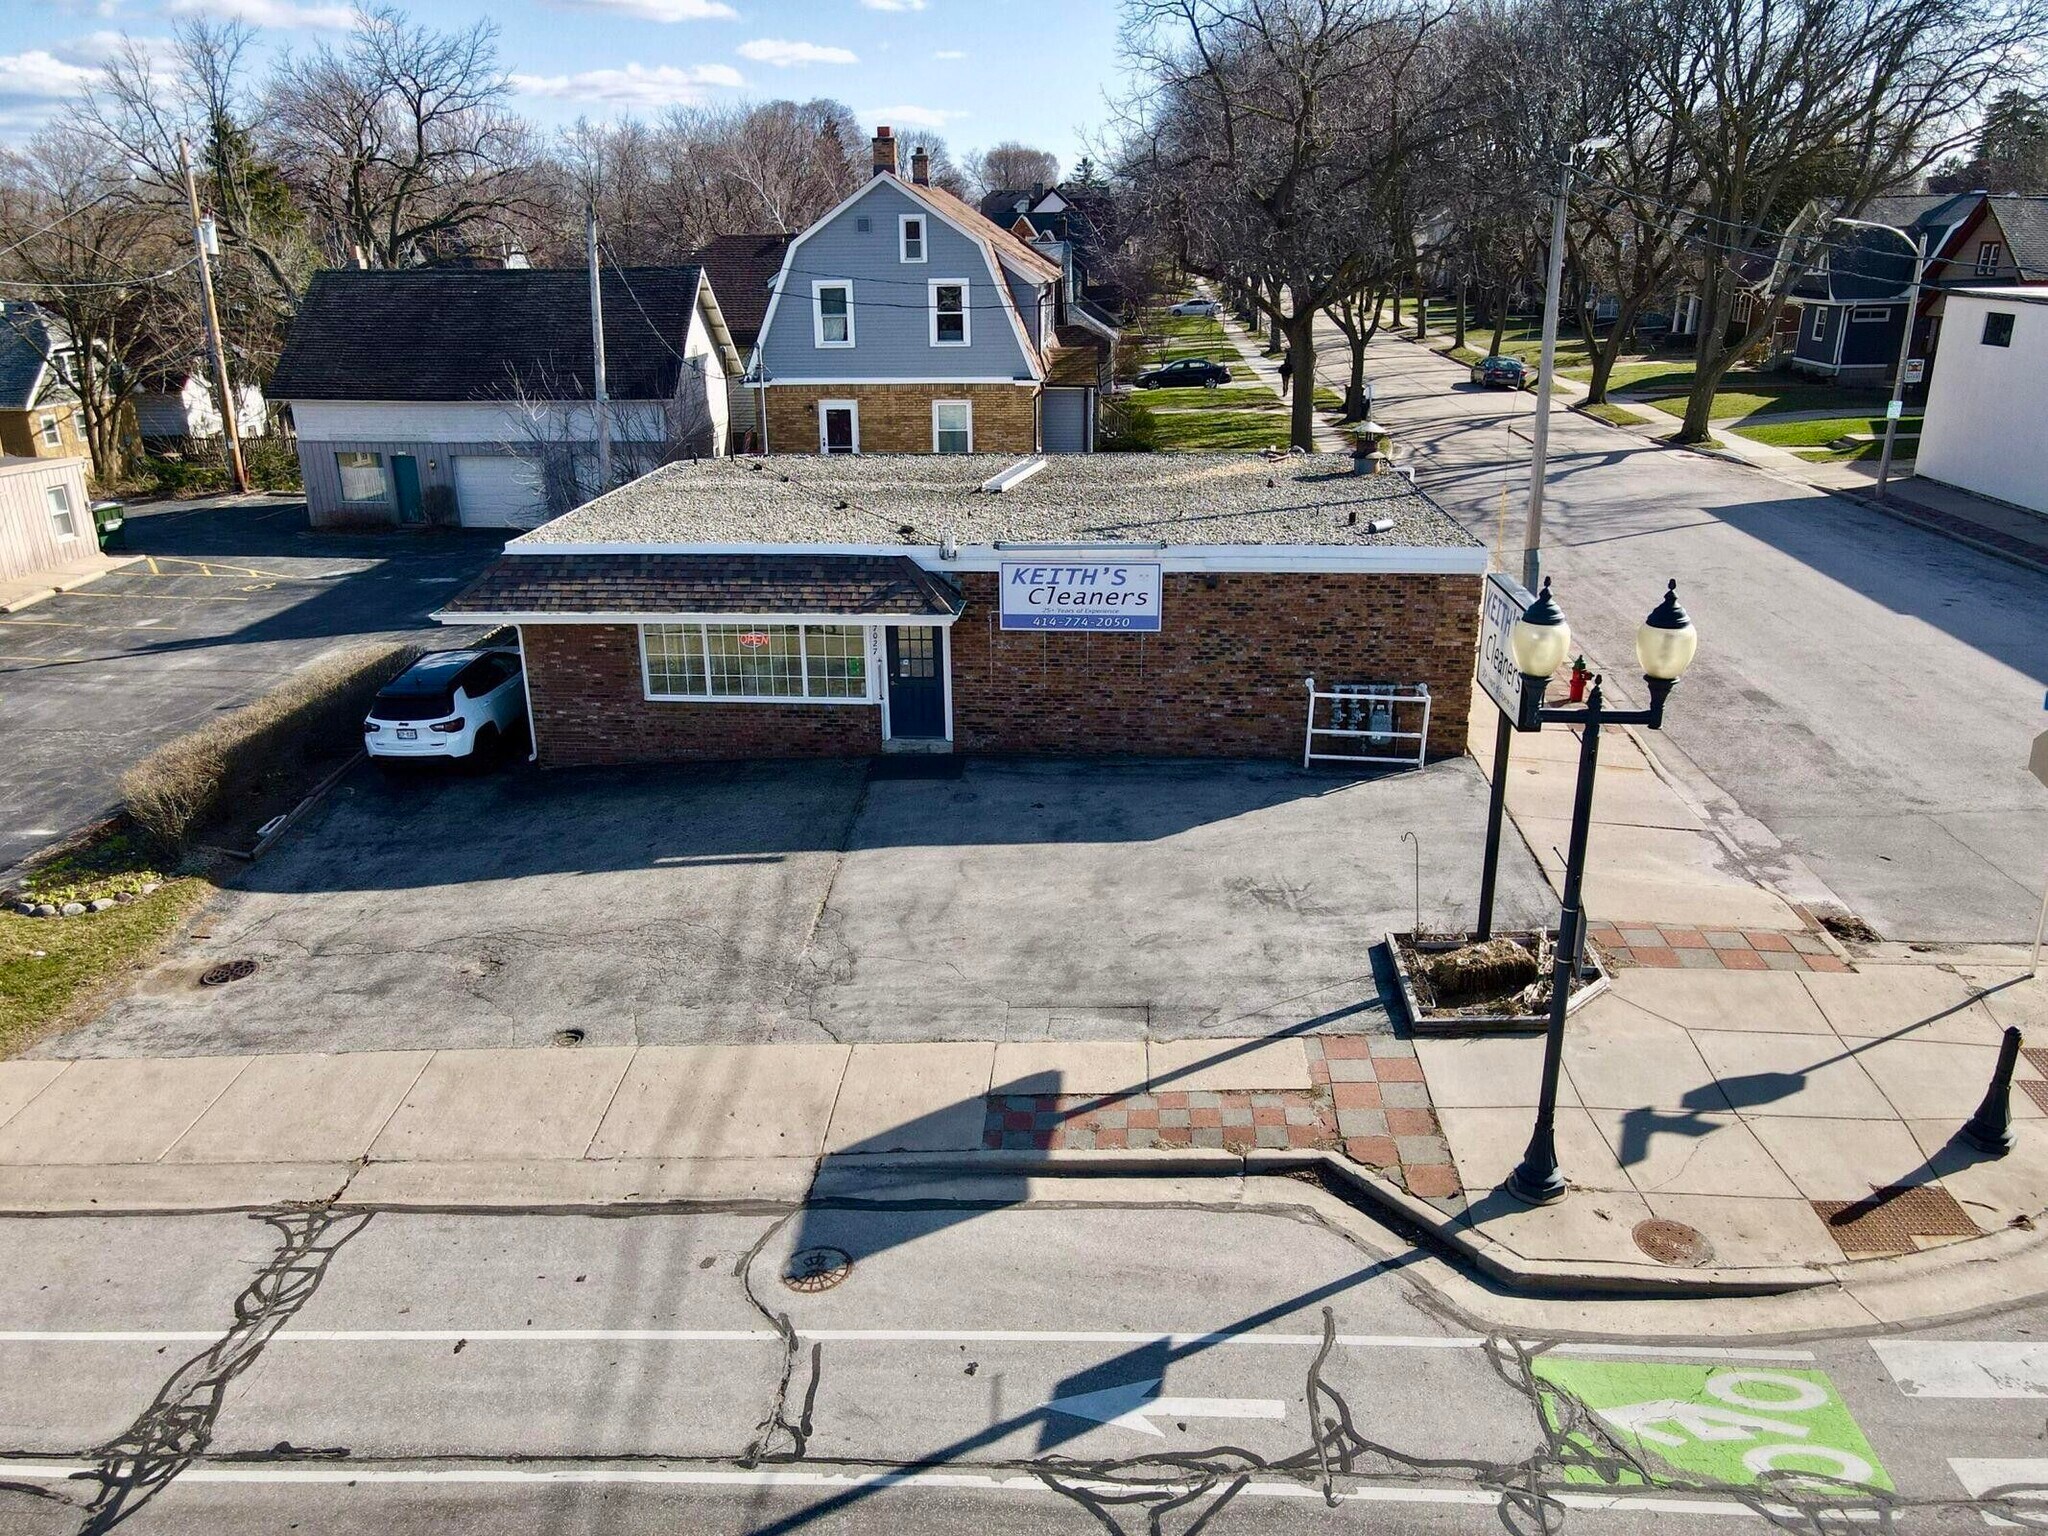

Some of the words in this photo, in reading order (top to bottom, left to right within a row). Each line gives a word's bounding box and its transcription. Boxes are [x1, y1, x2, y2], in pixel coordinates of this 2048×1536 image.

[1011, 567, 1127, 586] KEITH'S
[1028, 586, 1149, 606] Cleaners
[1084, 607, 1120, 615] Experience
[1032, 617, 1130, 628] 414-774-2050
[739, 634, 769, 645] OPEN
[1485, 633, 1522, 694] Cleaners
